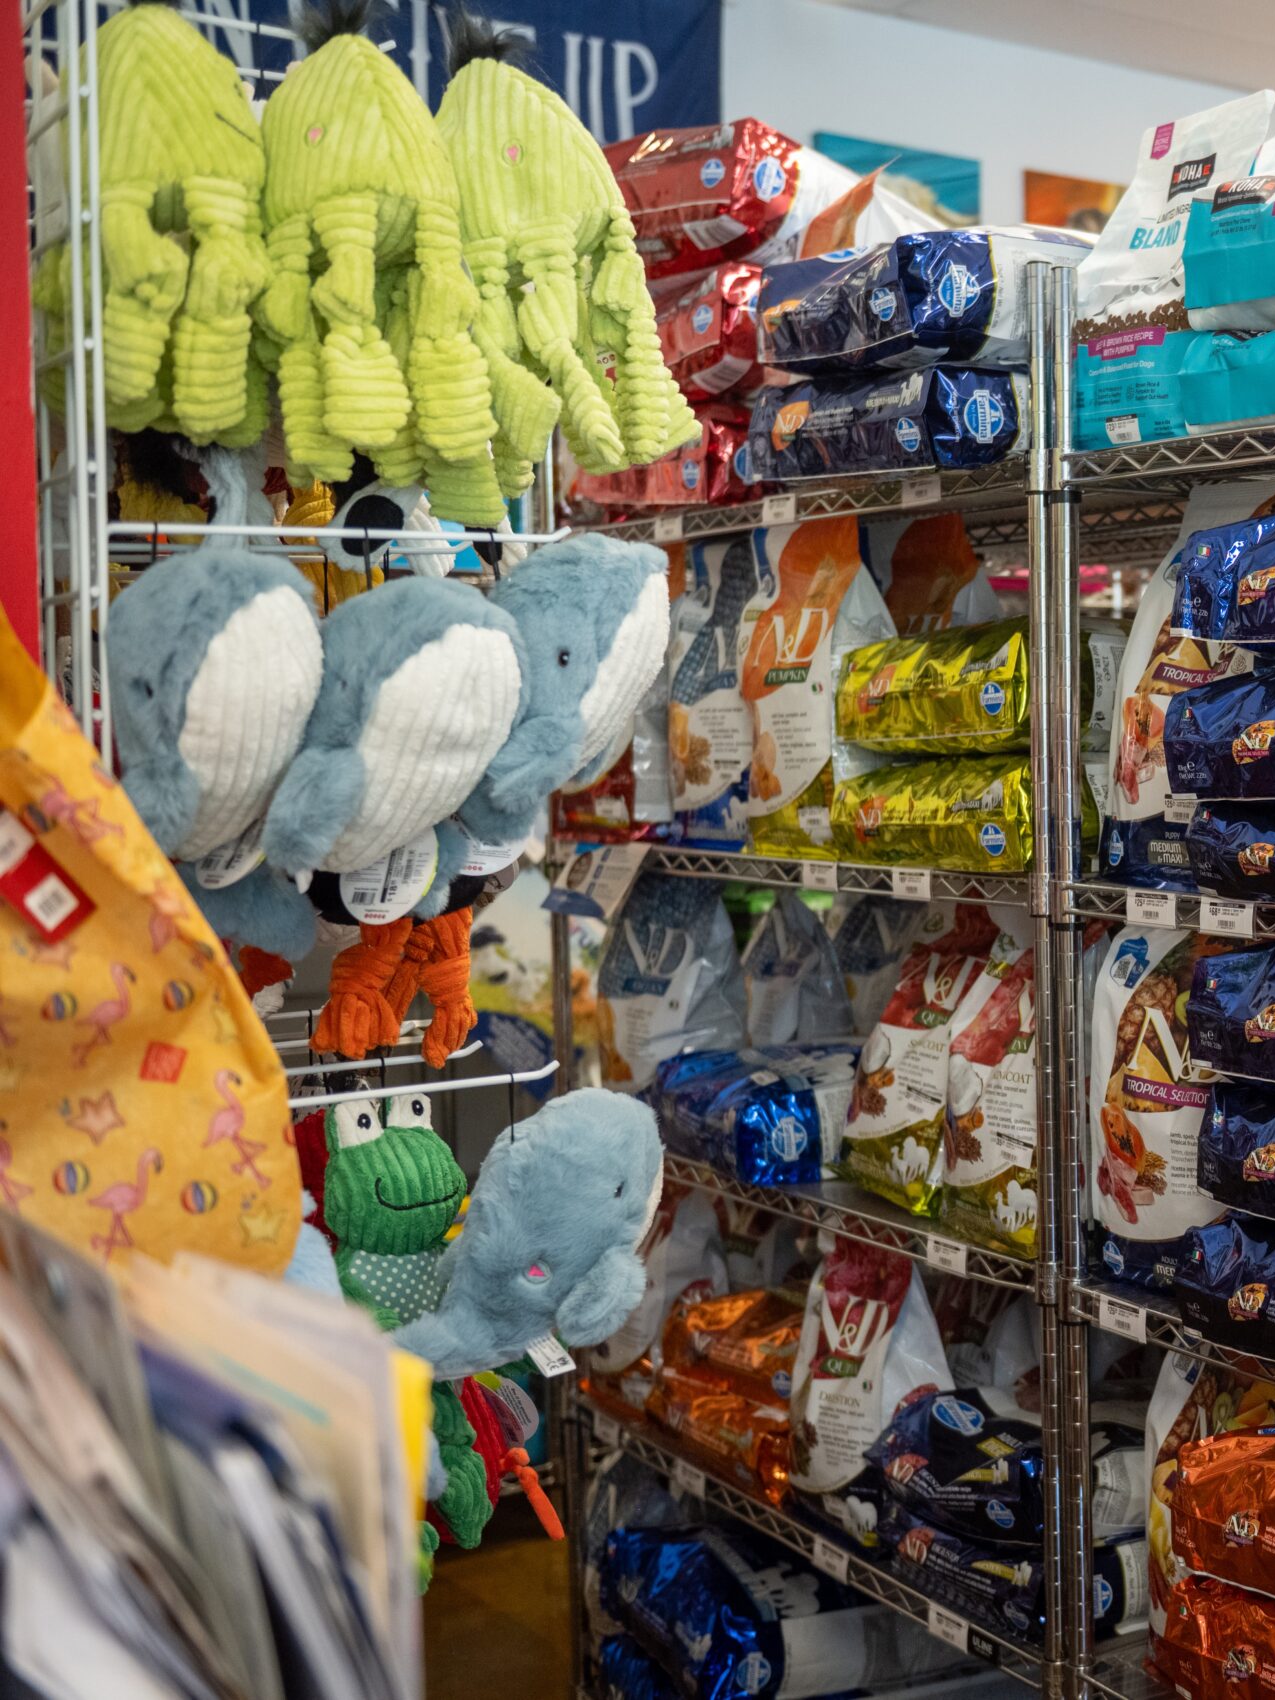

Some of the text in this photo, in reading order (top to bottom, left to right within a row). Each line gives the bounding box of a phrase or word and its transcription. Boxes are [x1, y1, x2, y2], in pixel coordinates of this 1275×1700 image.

[563, 33, 658, 144] UP
[1129, 219, 1181, 249] BLAND
[978, 392, 988, 439] Farmina
[1162, 666, 1205, 684] TROPICAL
[1165, 832, 1181, 841] PUPPY
[1151, 841, 1181, 854] MEDIUM
[1163, 852, 1183, 865] MAXI
[1126, 1079, 1168, 1101] TROPICAL
